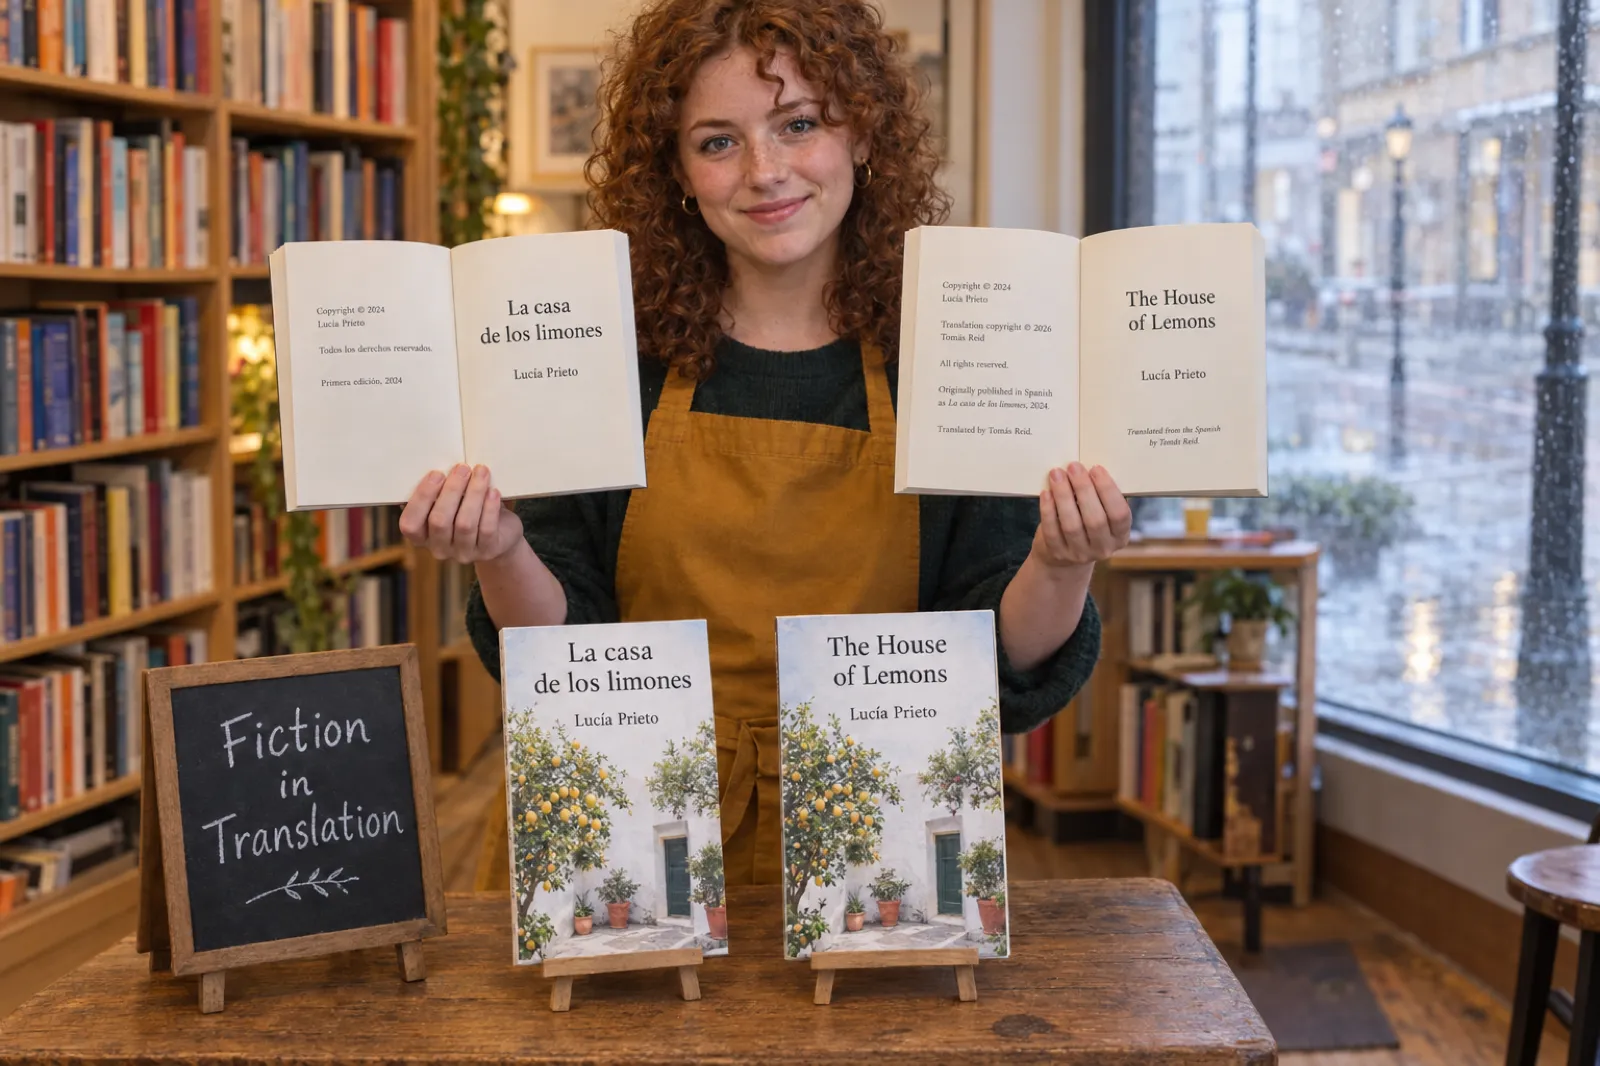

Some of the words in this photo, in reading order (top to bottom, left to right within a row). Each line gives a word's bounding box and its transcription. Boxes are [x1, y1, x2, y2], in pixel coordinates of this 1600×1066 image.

[942, 281, 981, 292] Copyright
[983, 282, 991, 290] ©
[993, 282, 1012, 291] 2024
[965, 294, 989, 304] Prieto
[1125, 289, 1158, 308] The
[1162, 288, 1216, 306] House
[316, 306, 355, 316] Copyright
[357, 305, 365, 314] ©
[367, 305, 385, 314] 2024
[507, 299, 529, 316] La
[534, 301, 571, 315] casa
[342, 318, 366, 328] Prieto
[940, 320, 984, 330] Translation
[985, 322, 1022, 333] copyright
[1024, 323, 1031, 331] ©
[1033, 324, 1052, 333] 2026
[1128, 313, 1149, 332] of
[1151, 313, 1216, 331] Lemons
[480, 326, 501, 345] de
[506, 325, 530, 343] los
[535, 323, 603, 341] limones
[968, 333, 985, 342] Reid
[319, 345, 343, 355] Todos
[344, 345, 356, 354] los
[357, 344, 391, 353] derechos
[393, 343, 433, 353] reservados.
[939, 359, 951, 368] All
[952, 359, 975, 370] rights
[976, 360, 1009, 369] reserved.
[513, 367, 543, 380] Lucía
[546, 366, 579, 378] Prieto
[1141, 368, 1171, 381] Lucía
[1174, 368, 1207, 380] Prieto
[321, 379, 351, 387] Primera
[384, 376, 403, 385] 2024
[938, 385, 976, 397] Originally
[977, 386, 1014, 397] published
[1015, 388, 1023, 396] in
[1024, 388, 1053, 399] Spanish
[948, 399, 958, 407] La
[977, 399, 986, 408] de
[987, 400, 998, 408] los
[1030, 401, 1050, 410] 2024.
[937, 425, 975, 434] Translated
[977, 426, 986, 436] by
[988, 426, 1012, 435] Tomás
[1014, 427, 1033, 436] Reid.
[1127, 426, 1163, 436] Translated
[1165, 426, 1181, 435] from
[1182, 425, 1193, 434] the
[1194, 425, 1221, 435] Spanish
[1149, 438, 1158, 449] by
[1182, 437, 1200, 446] Reid.
[567, 642, 598, 663] La
[604, 645, 653, 662] casa
[827, 635, 870, 657] The
[876, 634, 947, 656] House
[534, 672, 561, 695] de
[567, 671, 600, 693] los
[607, 669, 692, 692] limones
[833, 664, 857, 687] of
[862, 664, 948, 685] Lemons
[575, 711, 613, 727] Lucía
[617, 711, 659, 726] Prieto
[850, 705, 889, 721] Lucía
[893, 705, 937, 719] Prieto
[220, 706, 371, 768] Fiction
[280, 769, 314, 799] in
[201, 800, 404, 864] Translation
